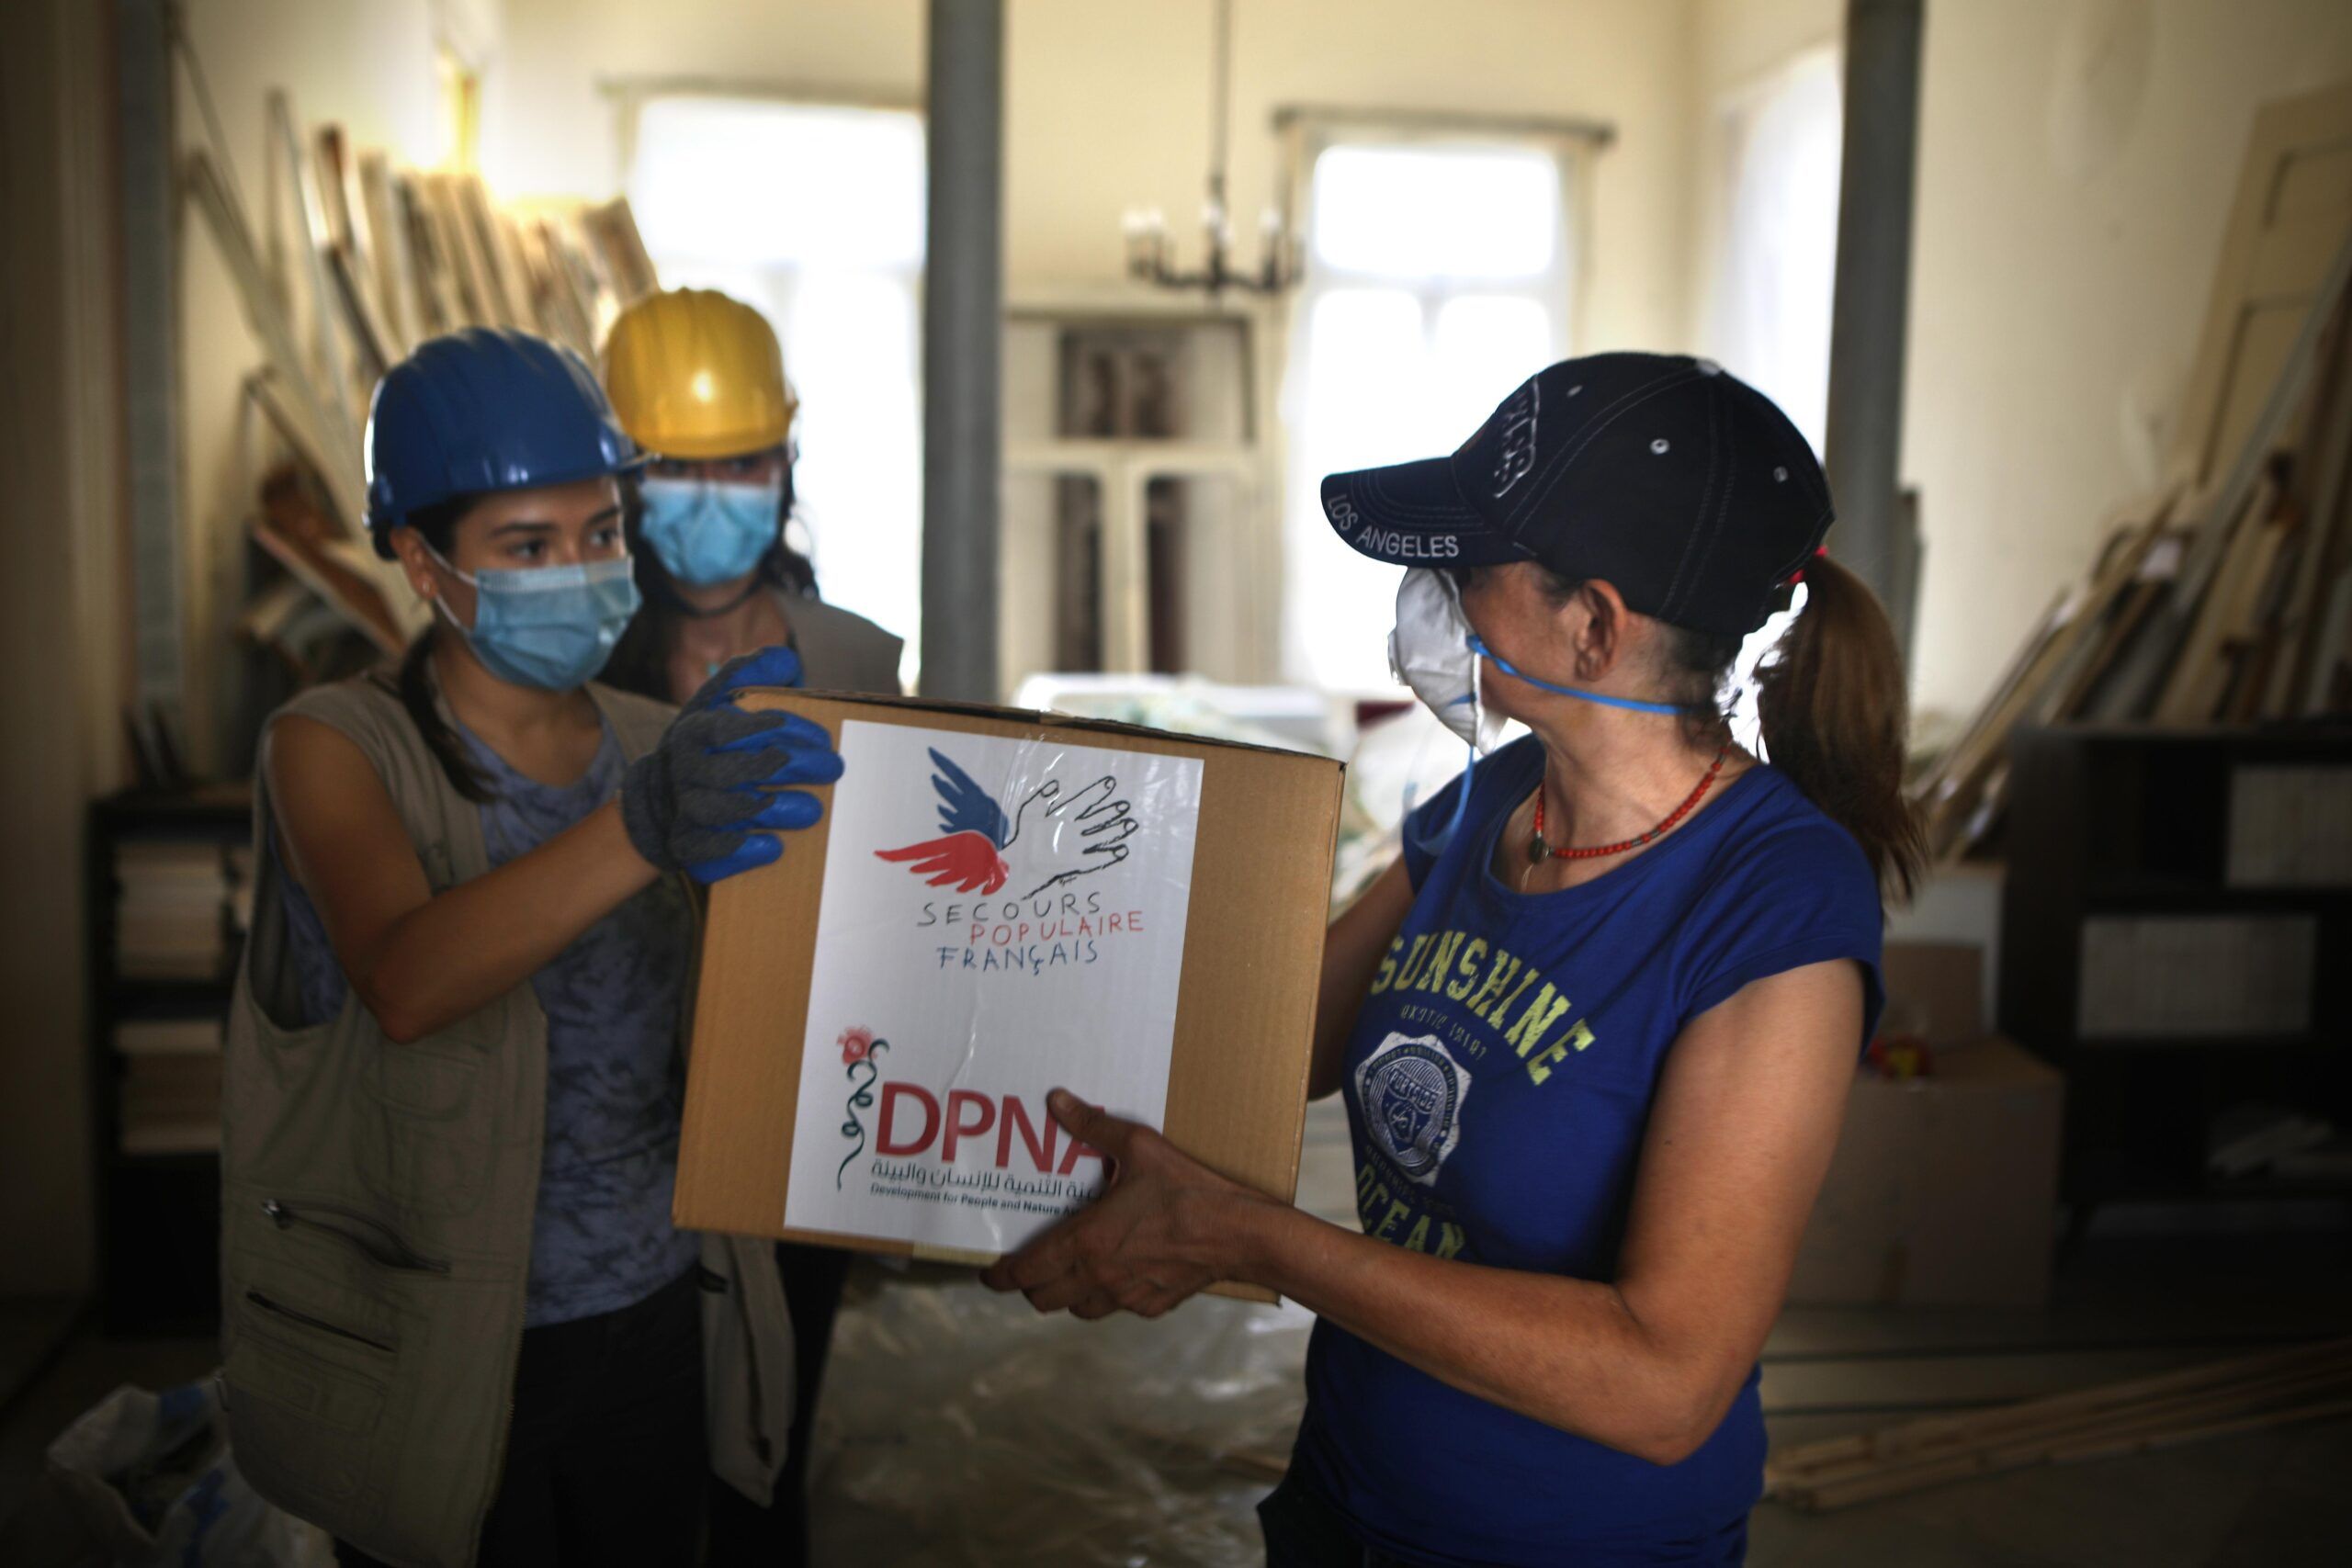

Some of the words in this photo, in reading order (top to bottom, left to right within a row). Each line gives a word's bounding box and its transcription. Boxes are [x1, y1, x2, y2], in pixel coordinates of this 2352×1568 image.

[1328, 493, 1358, 532] LOS
[1356, 525, 1459, 558] ANGELES
[917, 891, 1102, 927] SECOURS
[969, 910, 1145, 947] POPULAIRE
[936, 939, 1099, 976] FRANÇAIS
[1370, 930, 1597, 1086] SUNSHINE
[1389, 1068, 1438, 1114] PORTSIDE
[870, 1182, 941, 1204] Development
[944, 1190, 958, 1204] for
[961, 1194, 999, 1211] People
[1001, 1198, 1022, 1211] and
[1023, 1201, 1060, 1215] Nature
